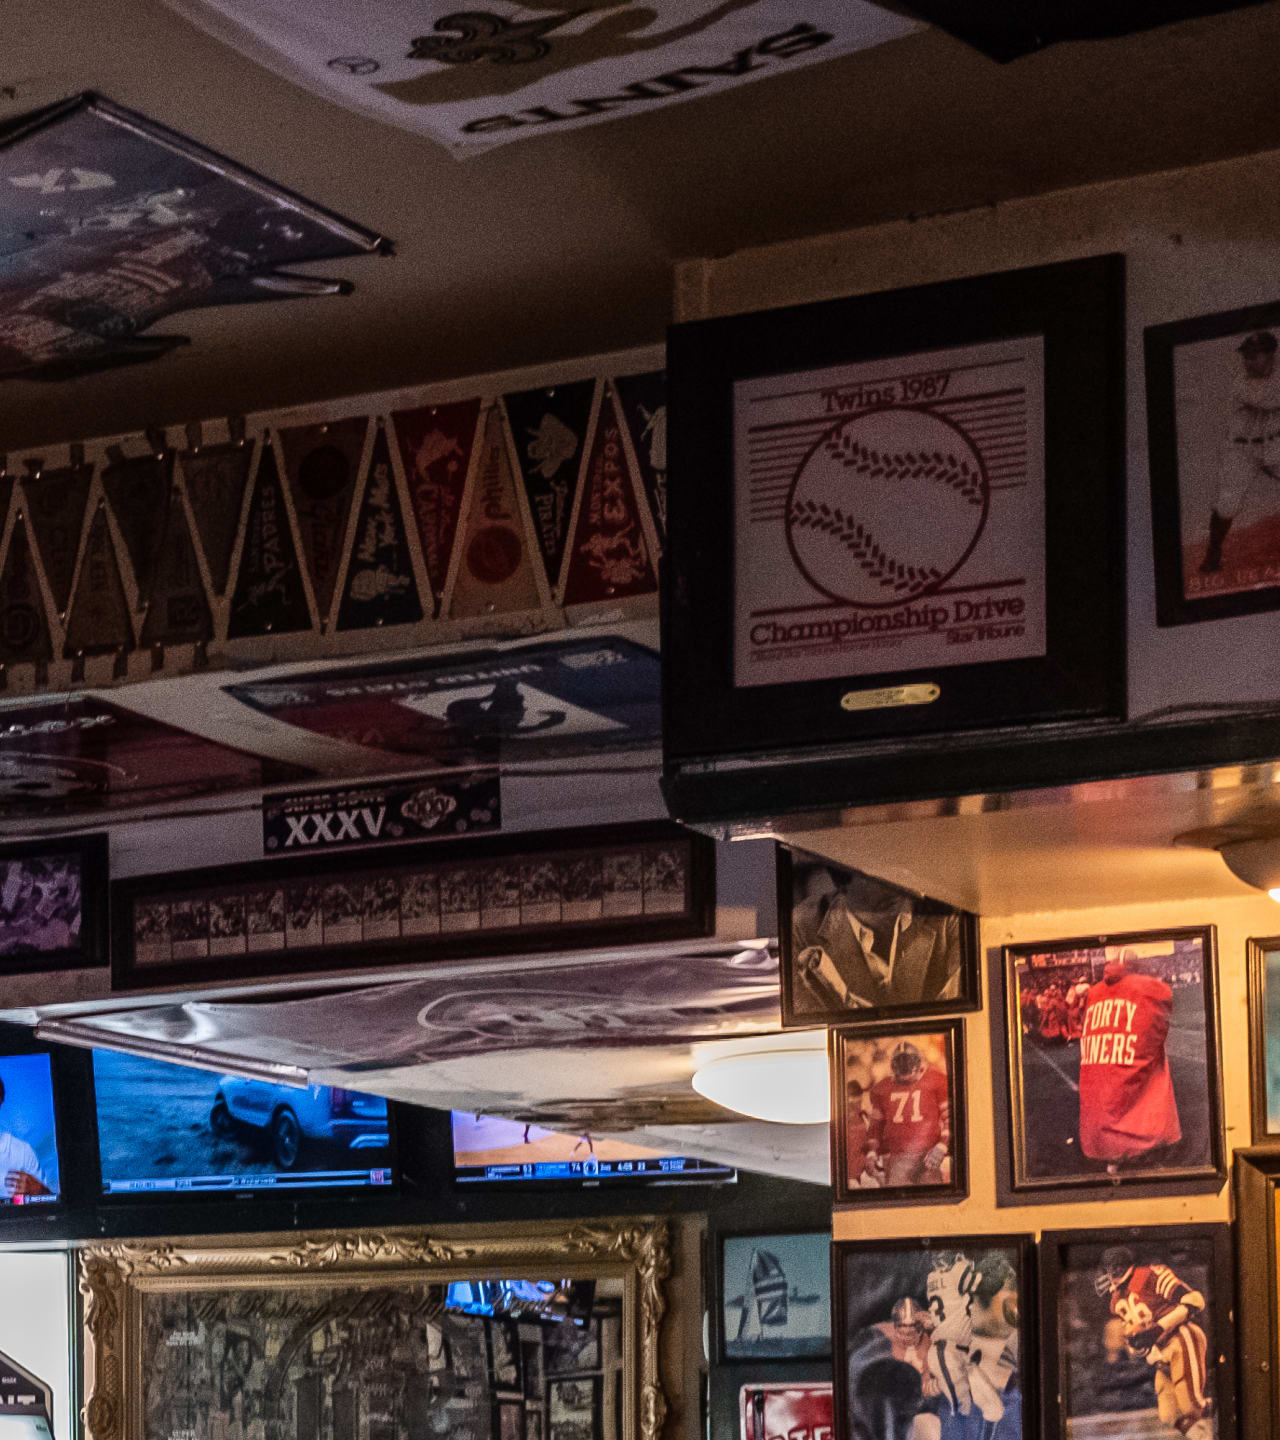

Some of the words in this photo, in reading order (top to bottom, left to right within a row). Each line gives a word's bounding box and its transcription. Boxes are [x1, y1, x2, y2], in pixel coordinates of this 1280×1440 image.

[821, 385, 896, 412] Twins
[900, 375, 951, 407] 1987
[603, 427, 627, 522] EXPOS
[750, 604, 949, 646] Championship
[954, 597, 1026, 623] Drive
[283, 806, 388, 847] XXXV
[1082, 998, 1138, 1037] FORTY
[889, 1089, 924, 1125] 71
